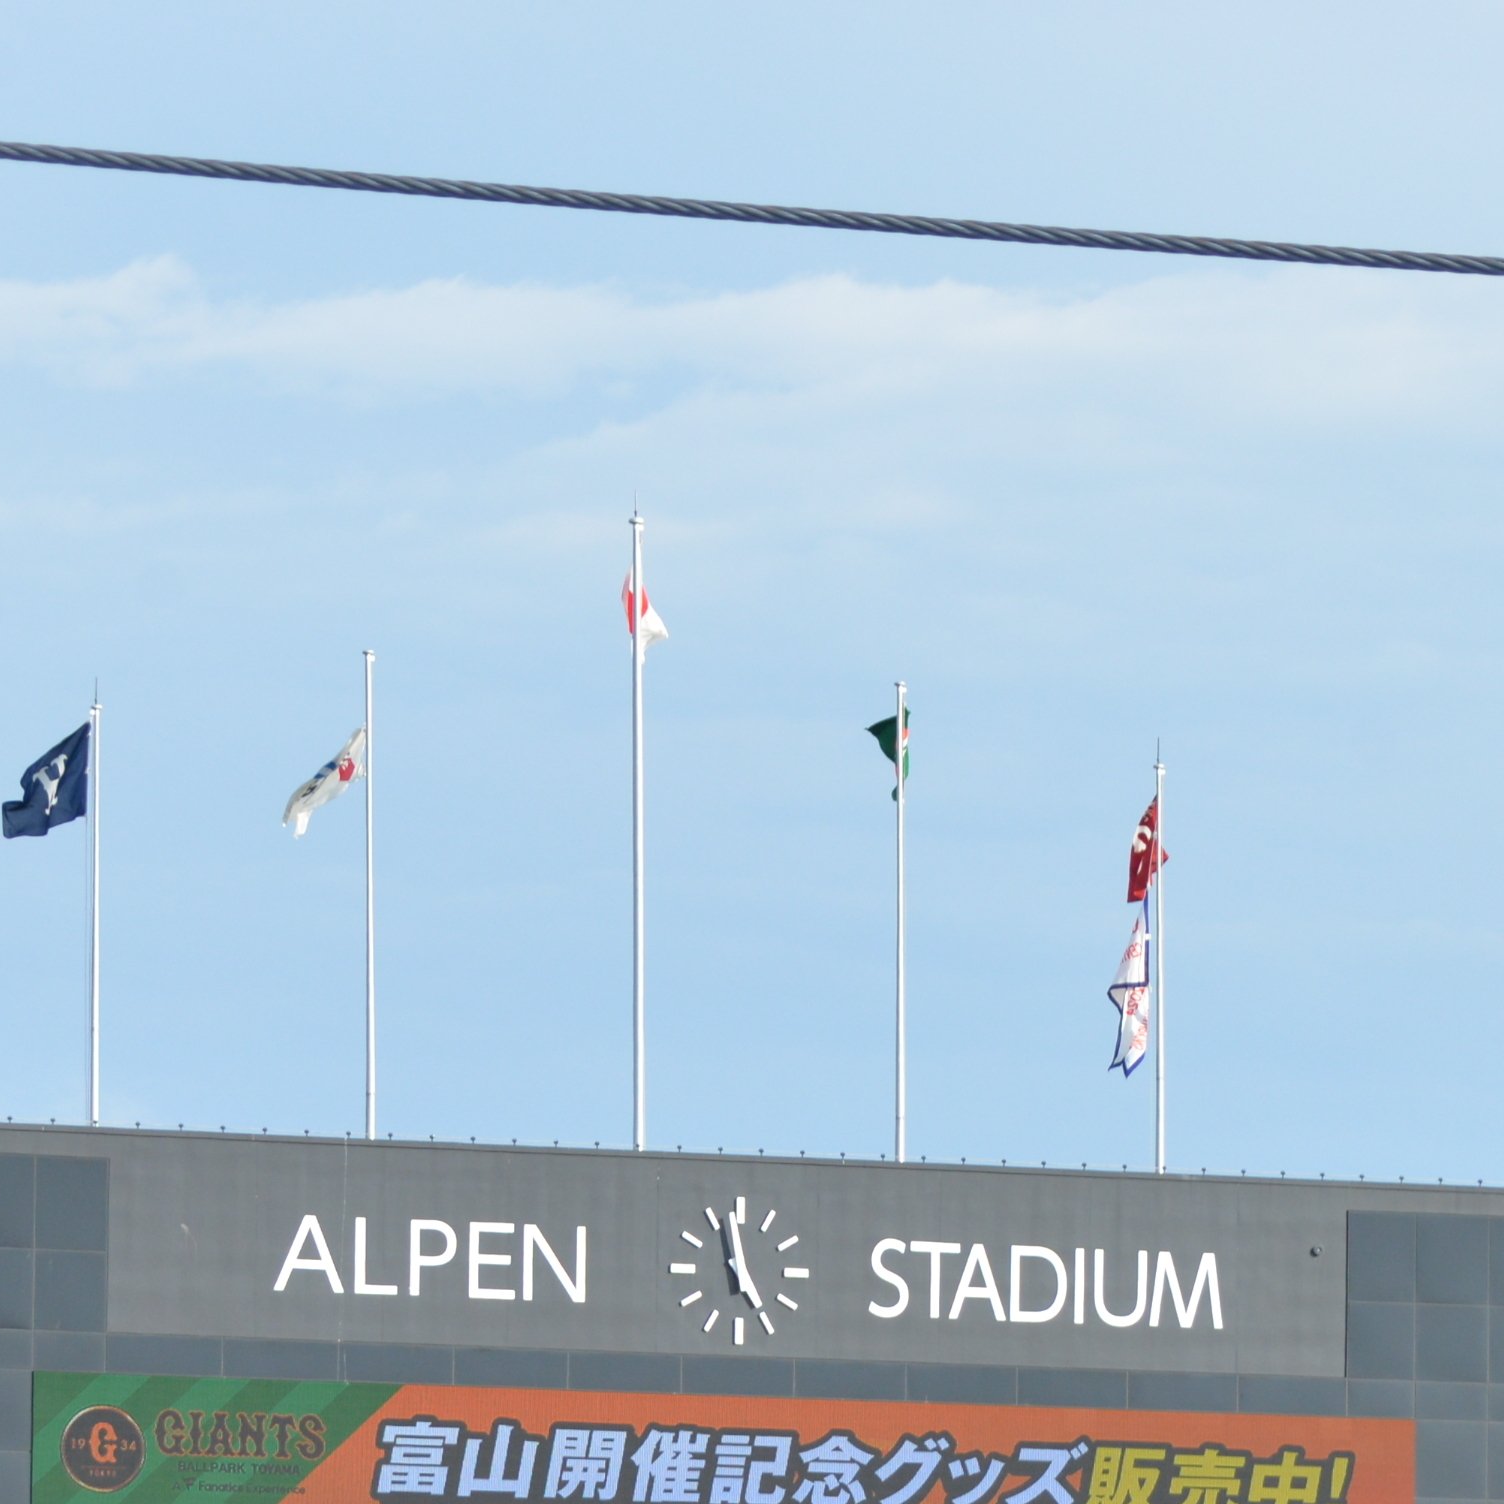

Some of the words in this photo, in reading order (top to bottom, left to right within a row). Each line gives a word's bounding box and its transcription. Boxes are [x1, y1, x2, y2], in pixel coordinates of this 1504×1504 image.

[274, 1213, 587, 1303] ALPEN
[868, 1238, 1224, 1330] STADIUM
[154, 1409, 326, 1460] GIANTS
[178, 1461, 246, 1474] BALLPARK
[252, 1463, 300, 1475] TOYAMA
[198, 1480, 243, 1492] Fanatics
[248, 1482, 305, 1494] Experience
